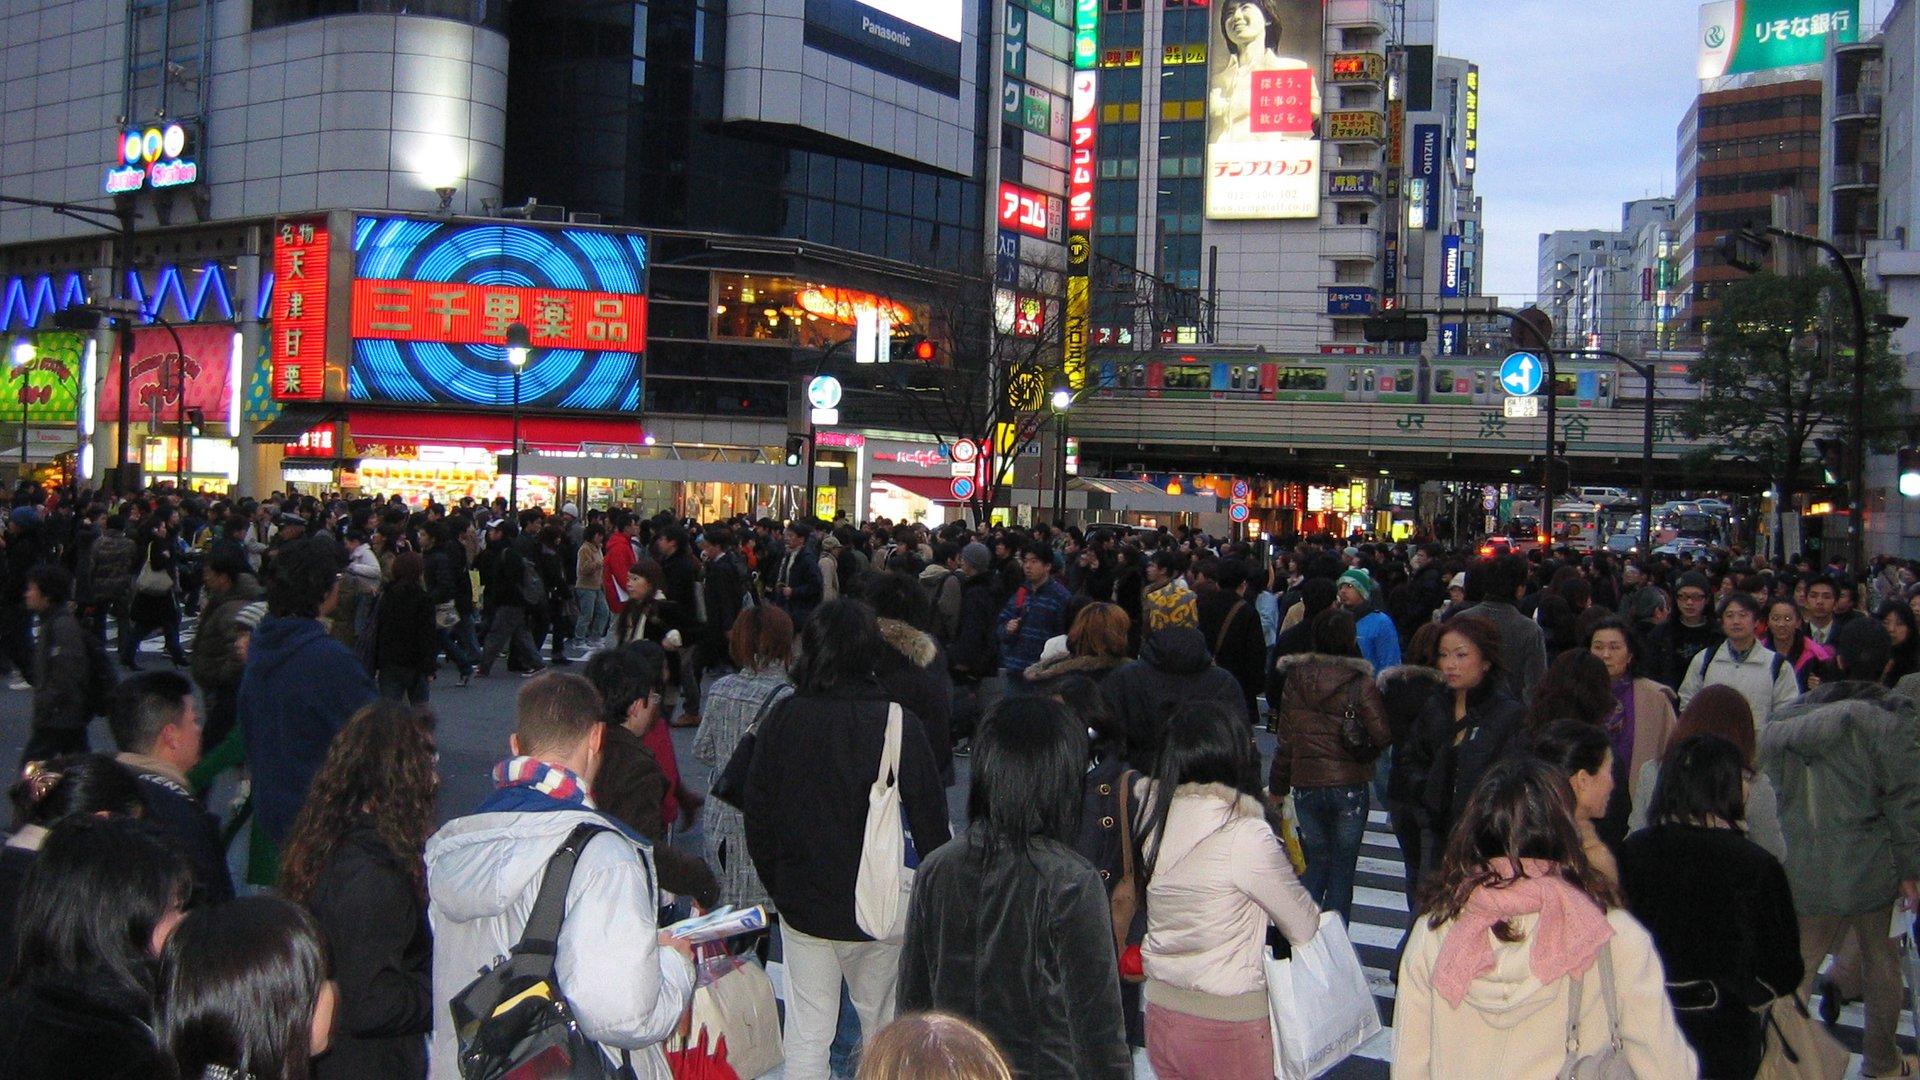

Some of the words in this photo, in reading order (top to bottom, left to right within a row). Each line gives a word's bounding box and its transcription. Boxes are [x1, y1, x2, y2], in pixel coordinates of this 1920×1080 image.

[862, 16, 911, 48] Panasonic
[1756, 11, 1849, 43] りそな銀行
[1073, 127, 1092, 184] アコム
[1424, 132, 1433, 174] MIZUHO
[1003, 191, 1046, 229] アコム
[281, 224, 314, 245] 名物
[1446, 248, 1458, 288] MIZUHO
[284, 250, 306, 393] 天津甘栗
[369, 287, 628, 342] 三千里薬品
[1396, 413, 1425, 429] JR
